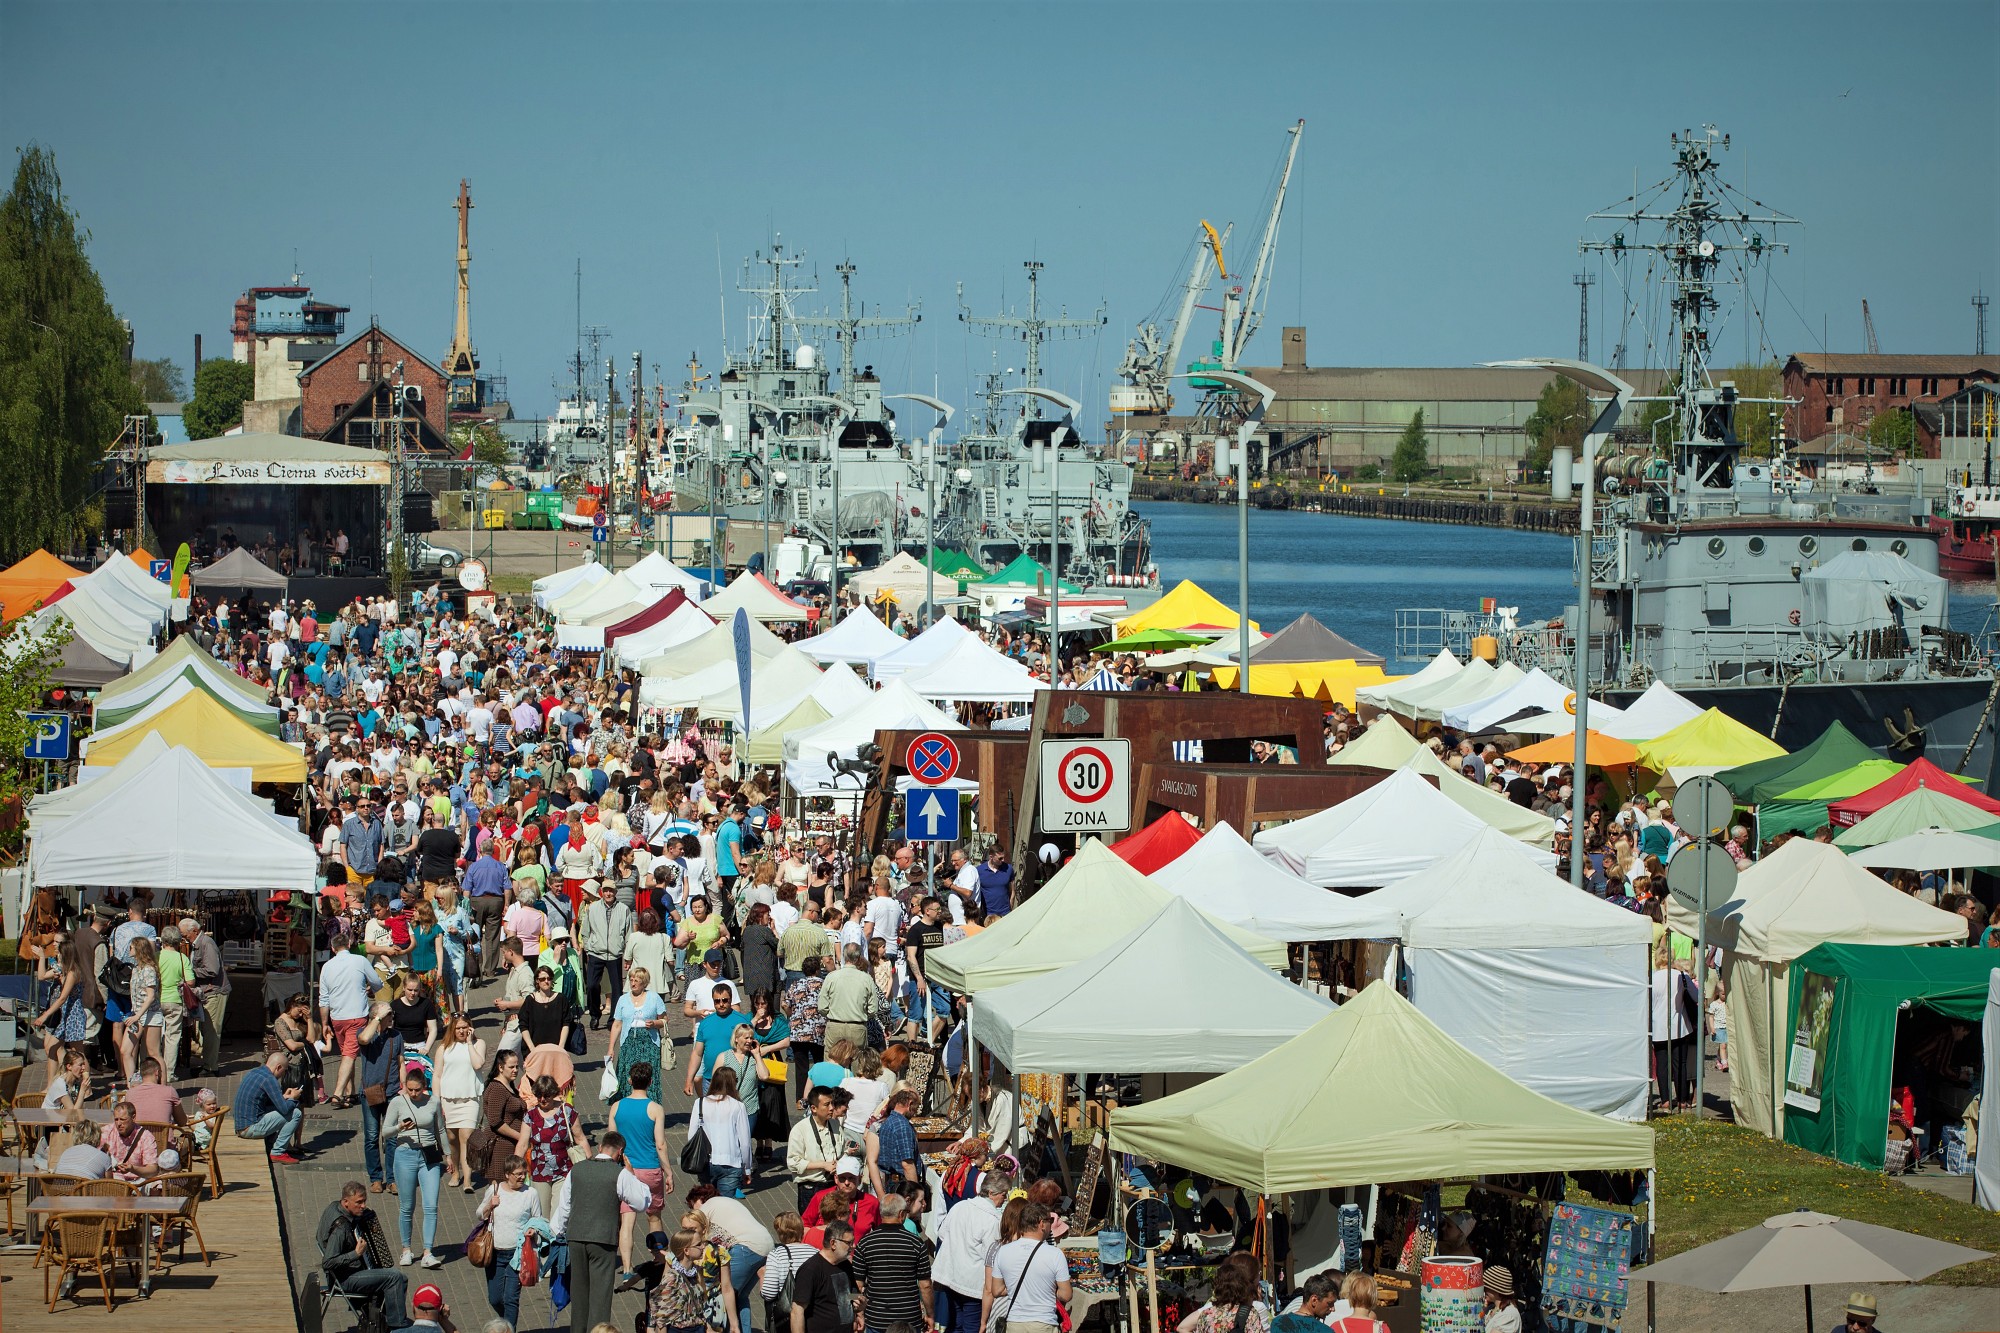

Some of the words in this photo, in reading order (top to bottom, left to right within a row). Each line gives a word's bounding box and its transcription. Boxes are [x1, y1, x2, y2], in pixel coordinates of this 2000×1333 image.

[205, 462, 259, 482] Līvas
[267, 462, 317, 478] Ciema
[324, 464, 367, 478] svētki
[36, 719, 61, 753] P
[1073, 762, 1100, 790] 30
[1160, 779, 1184, 795] SVAIGAS
[1064, 811, 1108, 825] ZONA
[923, 935, 943, 943] MUSE
[1587, 1287, 1597, 1299] V
